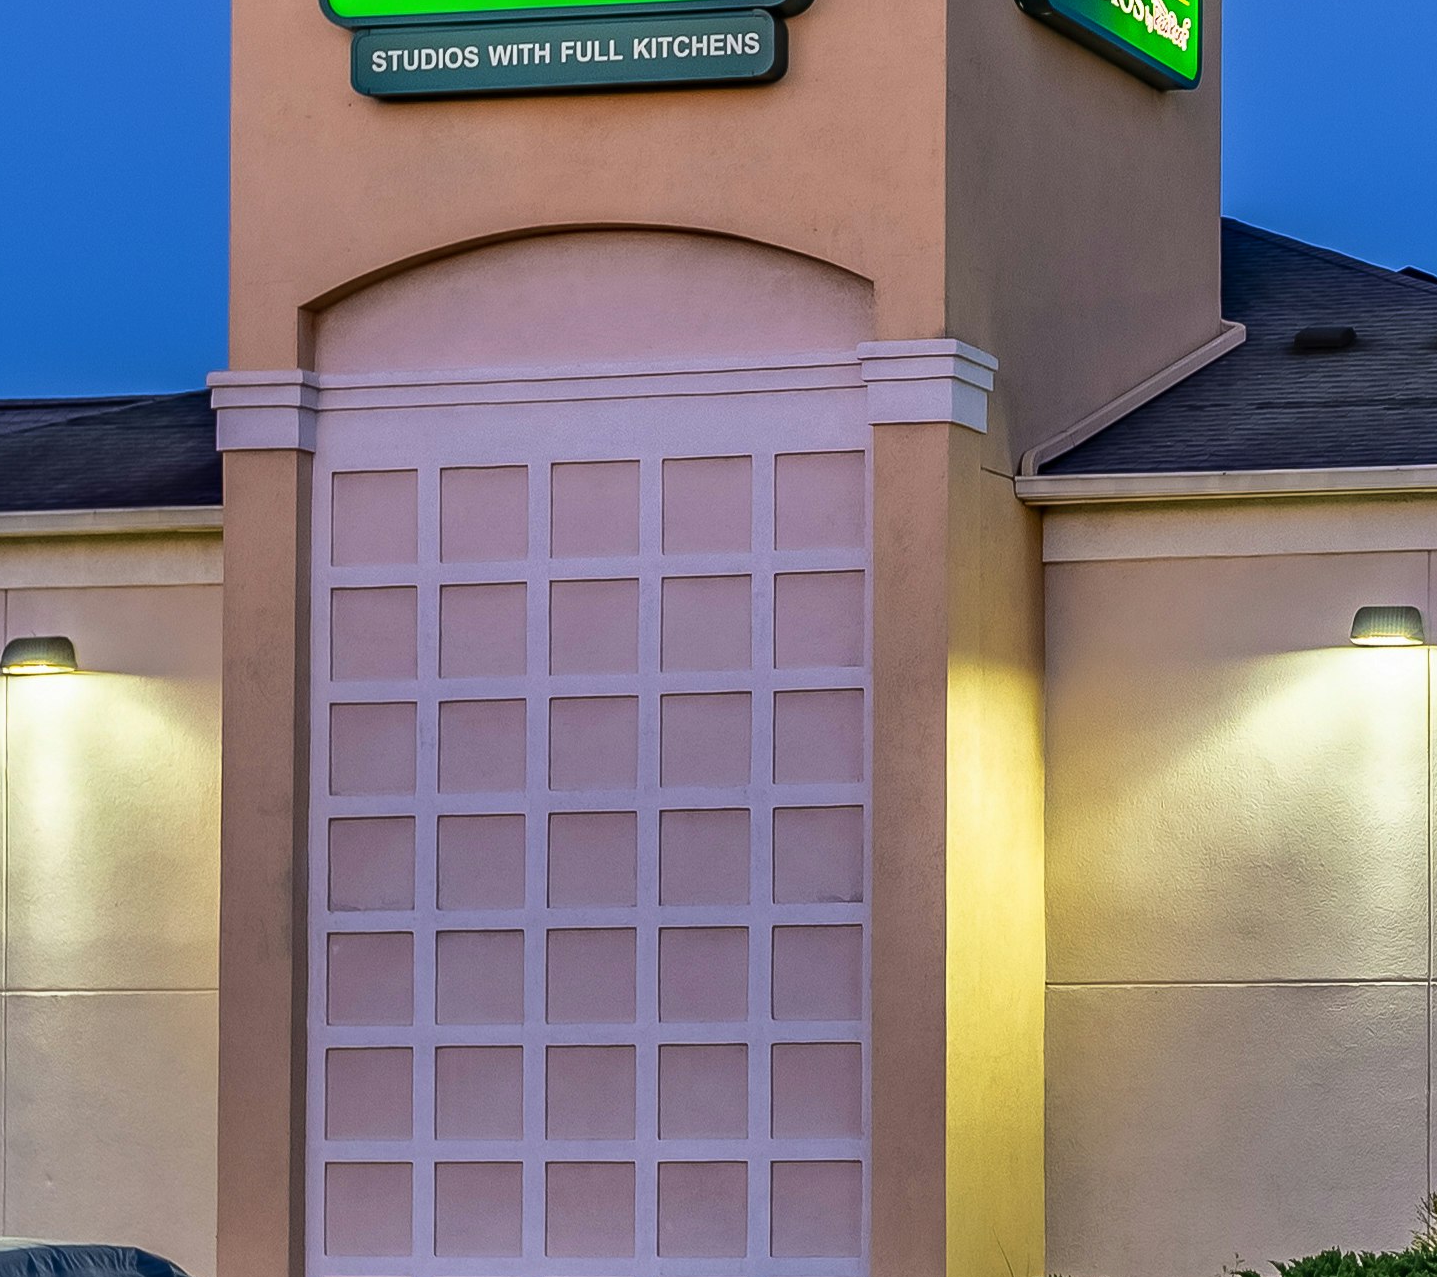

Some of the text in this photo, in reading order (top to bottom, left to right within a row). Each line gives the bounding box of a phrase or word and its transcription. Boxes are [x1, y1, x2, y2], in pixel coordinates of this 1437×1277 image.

[371, 32, 761, 72] STUDIOS WITH FULL KITCHENS
